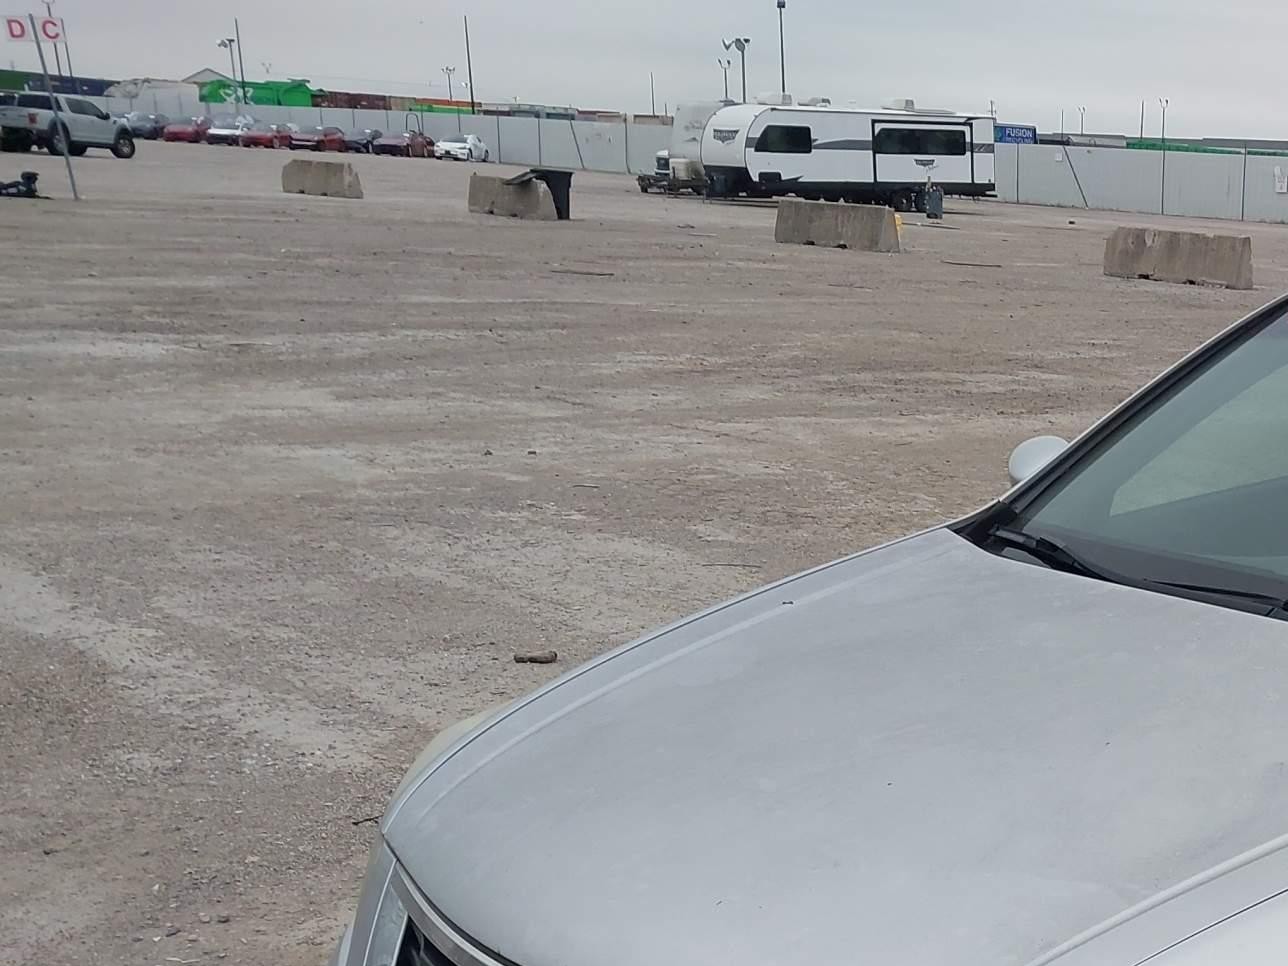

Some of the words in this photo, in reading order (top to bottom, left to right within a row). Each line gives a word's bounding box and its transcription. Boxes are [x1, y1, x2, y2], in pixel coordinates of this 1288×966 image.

[7, 19, 26, 38] D
[42, 20, 60, 40] C
[1005, 127, 1033, 138] FUSION
